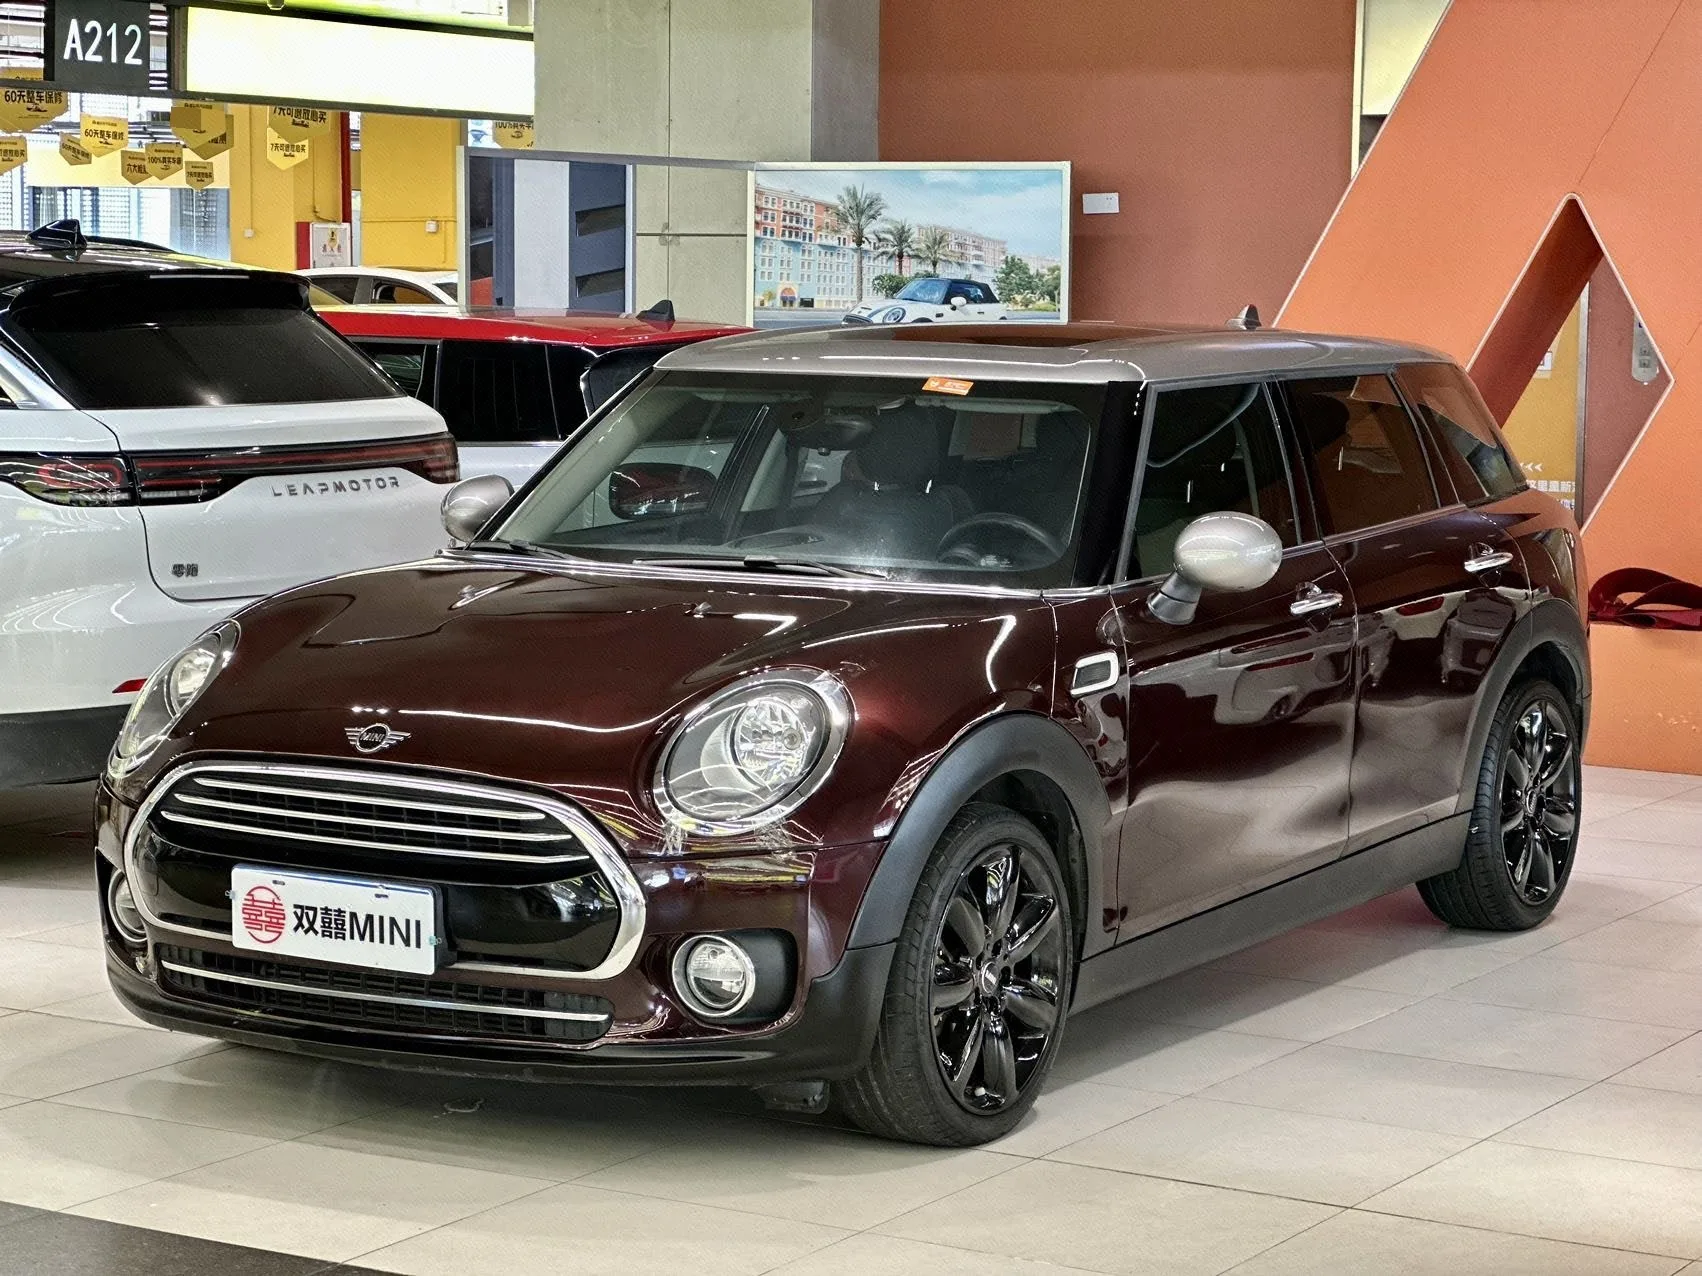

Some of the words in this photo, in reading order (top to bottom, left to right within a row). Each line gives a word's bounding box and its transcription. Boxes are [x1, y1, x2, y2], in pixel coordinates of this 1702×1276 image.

[63, 18, 142, 65] A212
[4, 90, 62, 104] 60天整车保修
[84, 128, 124, 140] 60天整车保修
[271, 476, 400, 497] LEAPMOTOR
[360, 732, 385, 742] MINI
